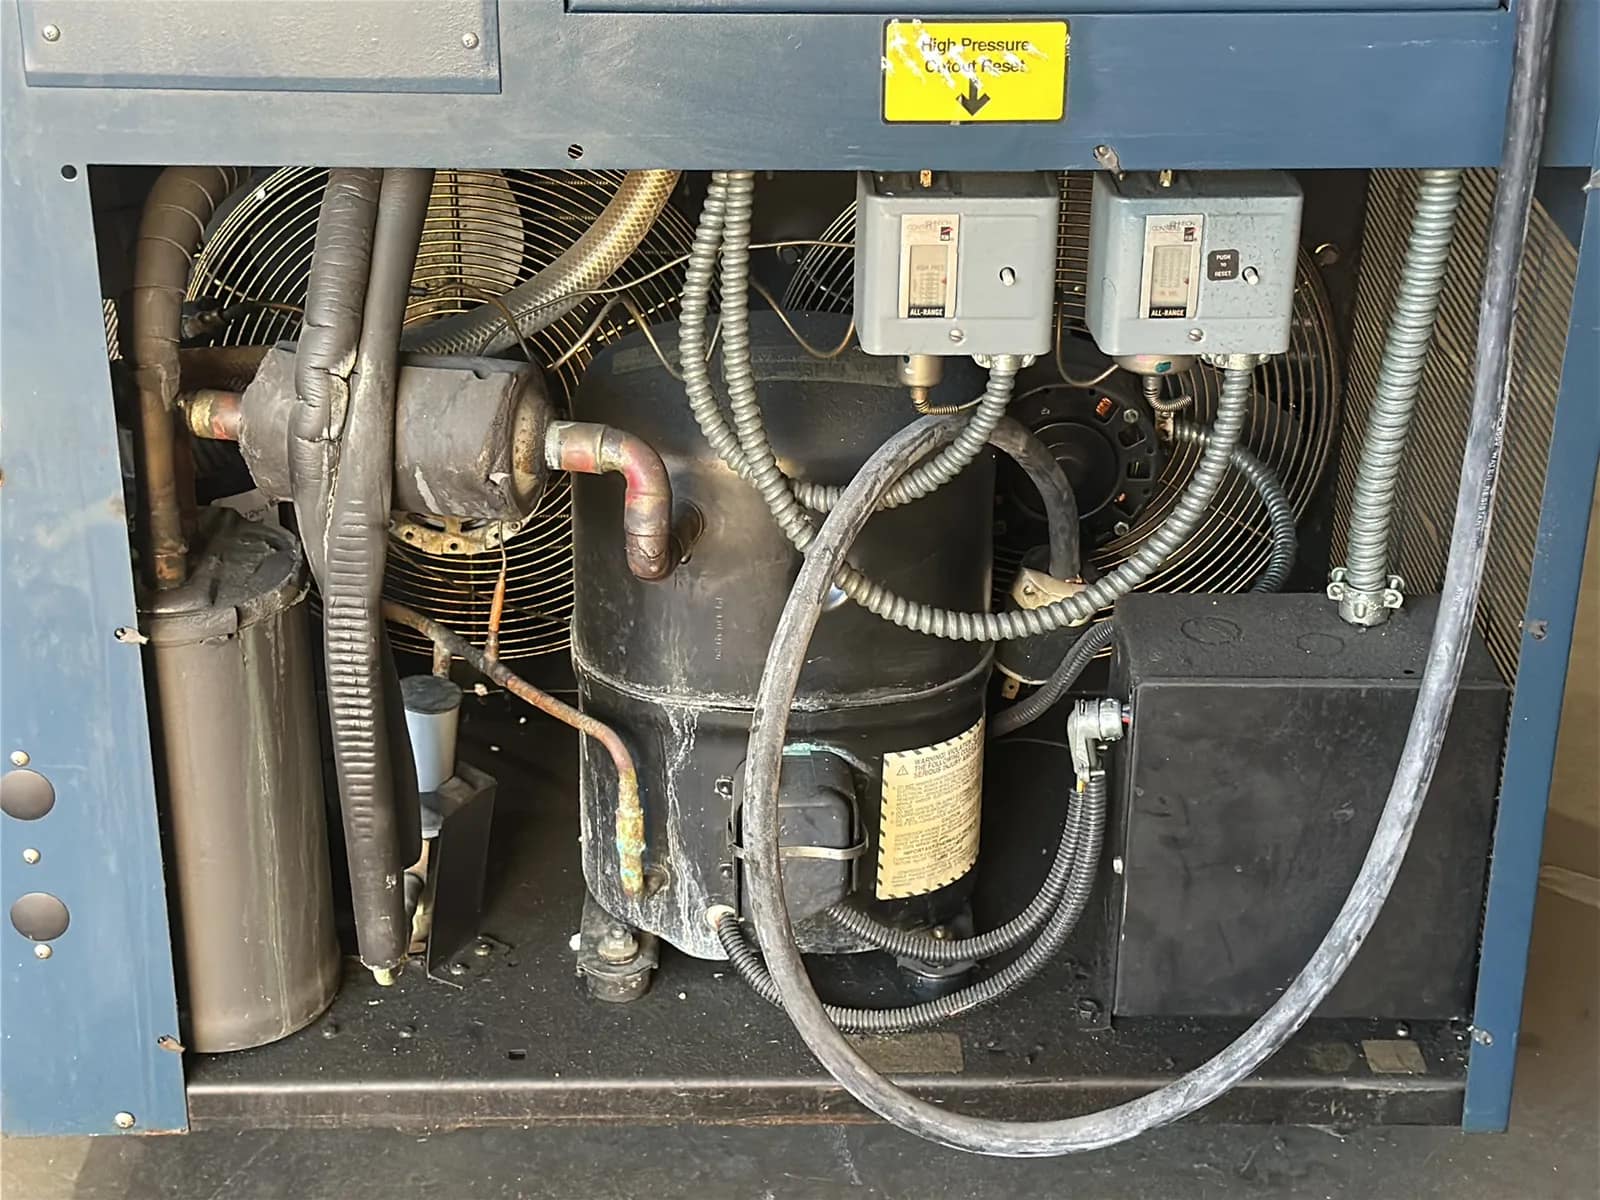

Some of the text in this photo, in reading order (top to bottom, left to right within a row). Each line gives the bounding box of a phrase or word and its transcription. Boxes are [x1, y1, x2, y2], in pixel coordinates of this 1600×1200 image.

[921, 38, 1029, 55] High Pressure
[925, 59, 1026, 73] Cutout Reset
[909, 308, 943, 316] ALL-RANGE
